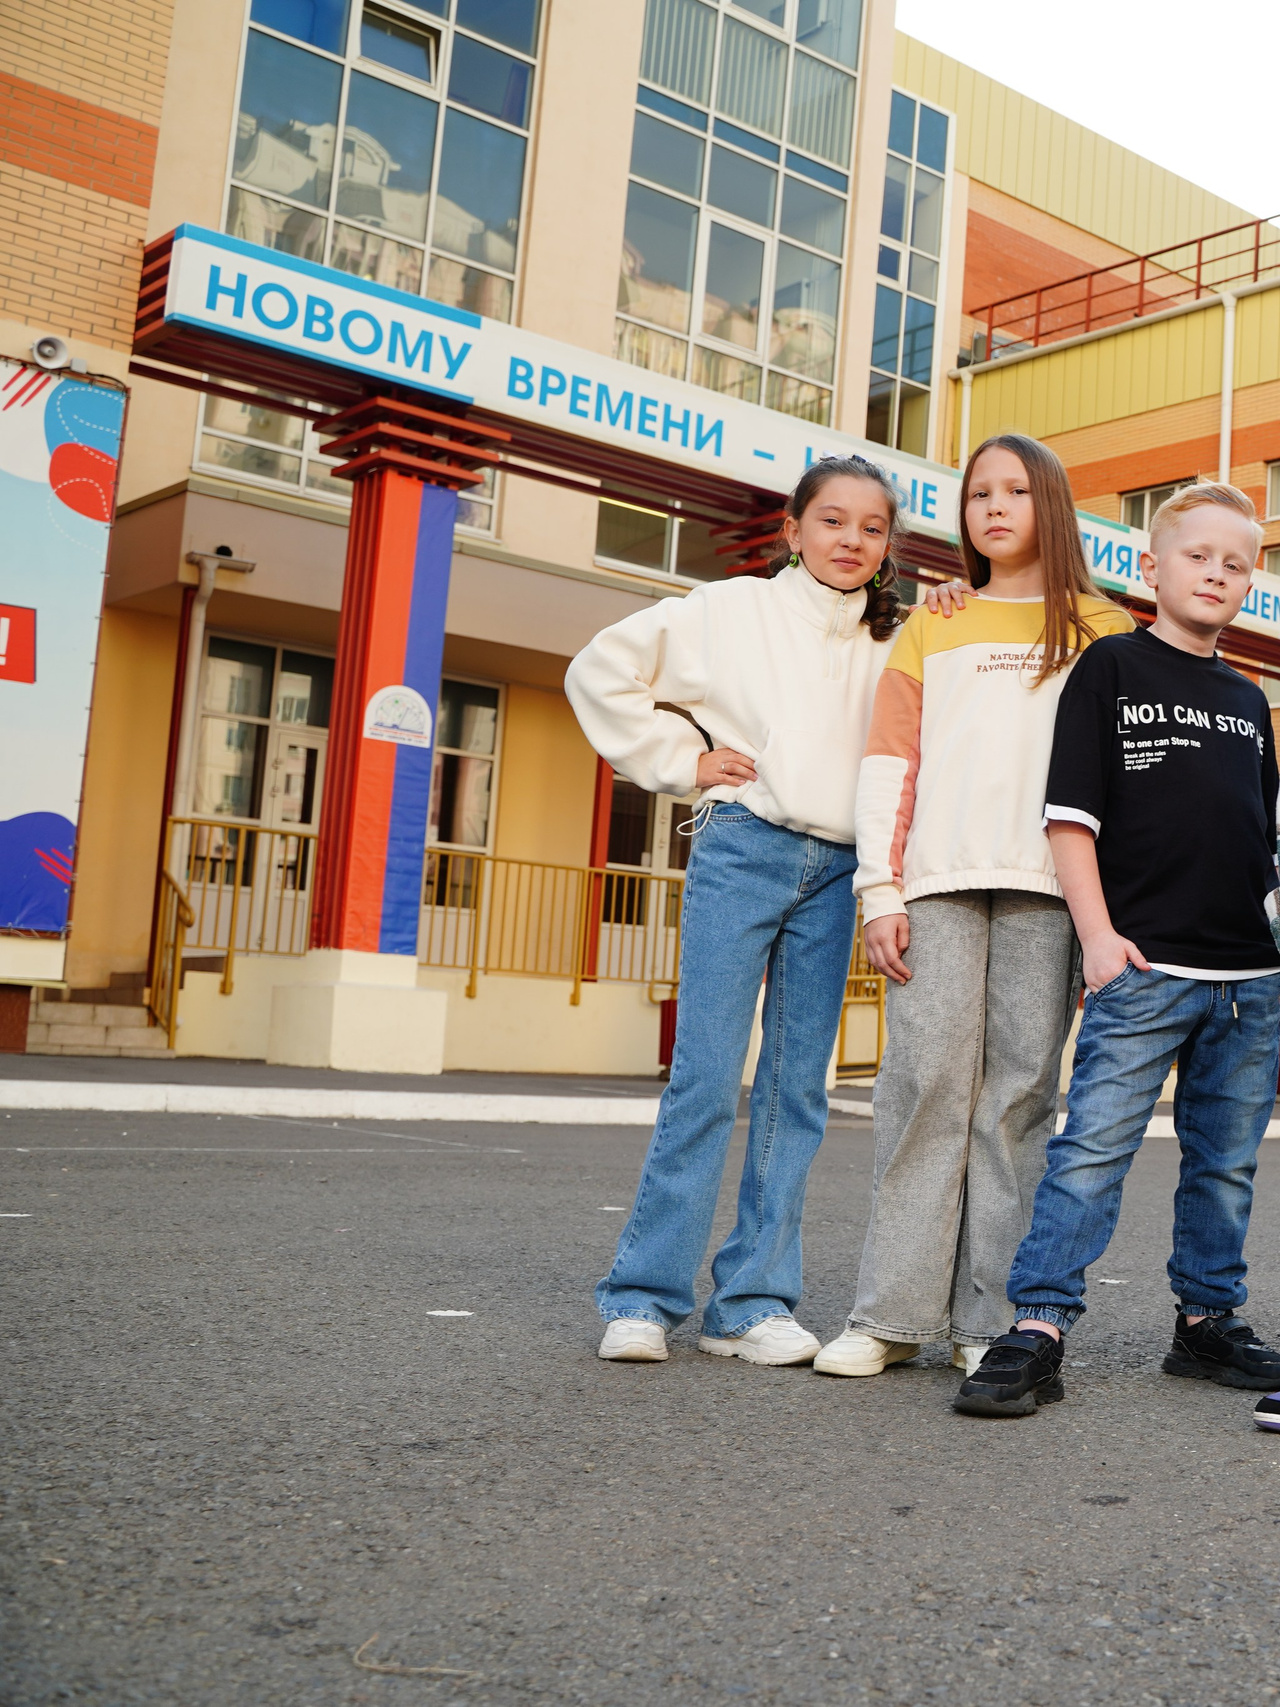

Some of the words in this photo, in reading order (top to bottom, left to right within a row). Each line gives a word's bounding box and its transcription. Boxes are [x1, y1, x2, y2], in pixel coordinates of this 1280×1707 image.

[205, 264, 472, 381] НОВОМУ
[507, 355, 724, 458] ВРЕМЕНИ
[990, 653, 1025, 661] NATURE
[977, 662, 1019, 673] FAVORITE
[1123, 703, 1167, 725] NO1
[1173, 705, 1211, 730] CAN
[1215, 713, 1256, 738] STOP
[1123, 740, 1135, 749] No
[1137, 740, 1152, 748] one
[1154, 738, 1169, 747] can
[1170, 736, 1189, 747] Stop
[1190, 740, 1201, 748] me
